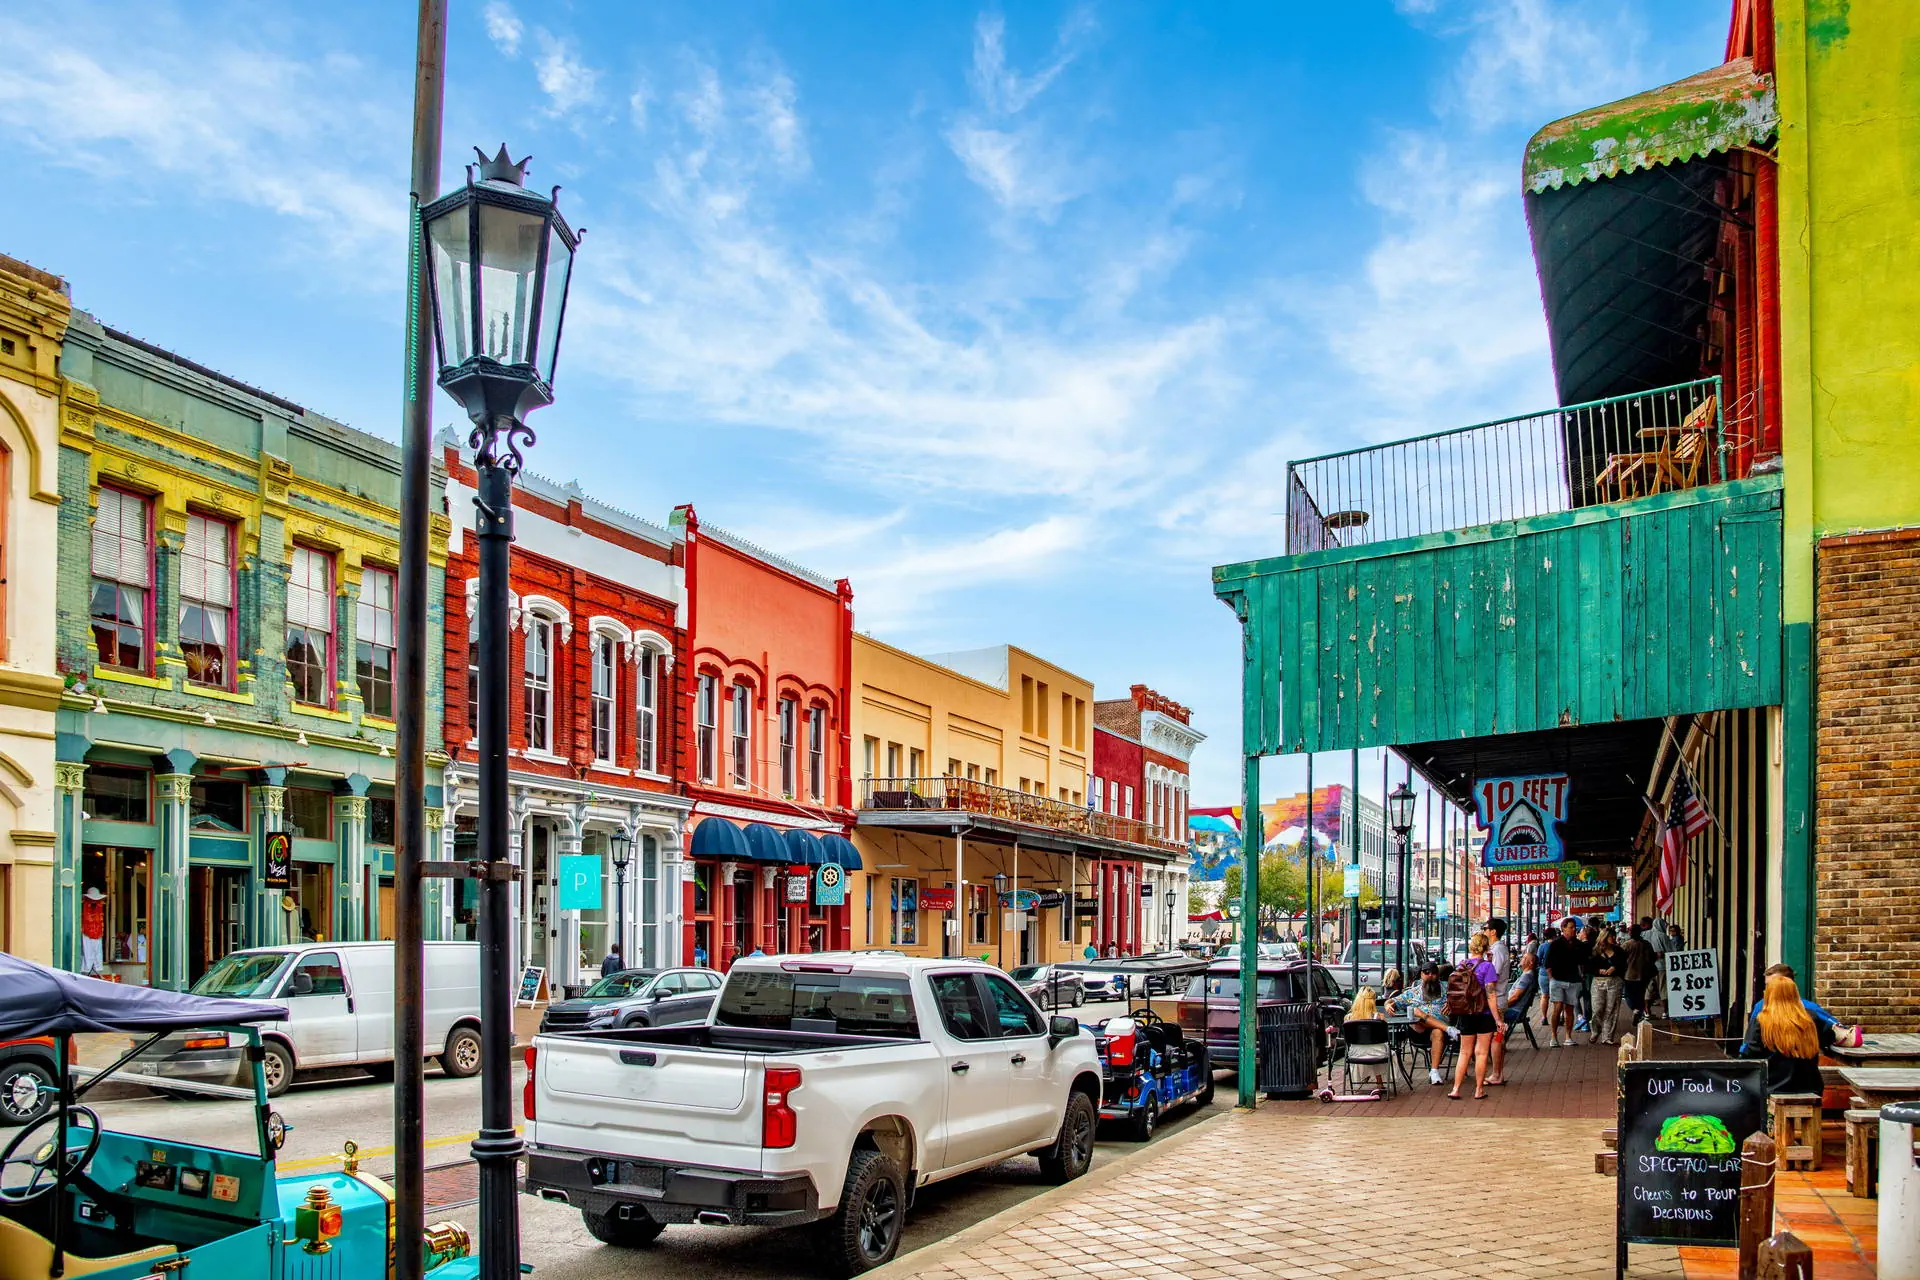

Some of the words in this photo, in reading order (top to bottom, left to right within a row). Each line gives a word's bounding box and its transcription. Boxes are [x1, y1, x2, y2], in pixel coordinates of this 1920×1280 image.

[1483, 781, 1514, 823] 10
[1522, 775, 1569, 820] FEET
[1494, 845, 1549, 861] UNDER
[574, 872, 587, 892] P
[1493, 872, 1521, 882] T-Shirts
[1528, 873, 1540, 881] for
[1541, 871, 1555, 880] $10
[1669, 952, 1713, 971] BEER
[1671, 977, 1681, 991] 2
[1686, 973, 1714, 990] for
[1683, 994, 1705, 1011] $5
[1647, 1078, 1675, 1095] Our
[1682, 1078, 1714, 1093] Food
[1726, 1079, 1742, 1093] IS
[1639, 1155, 1743, 1173] SPEC-TACO-LAR
[1633, 1185, 1673, 1201] Cheers
[1681, 1187, 1697, 1200] to
[1704, 1187, 1737, 1201] Pour
